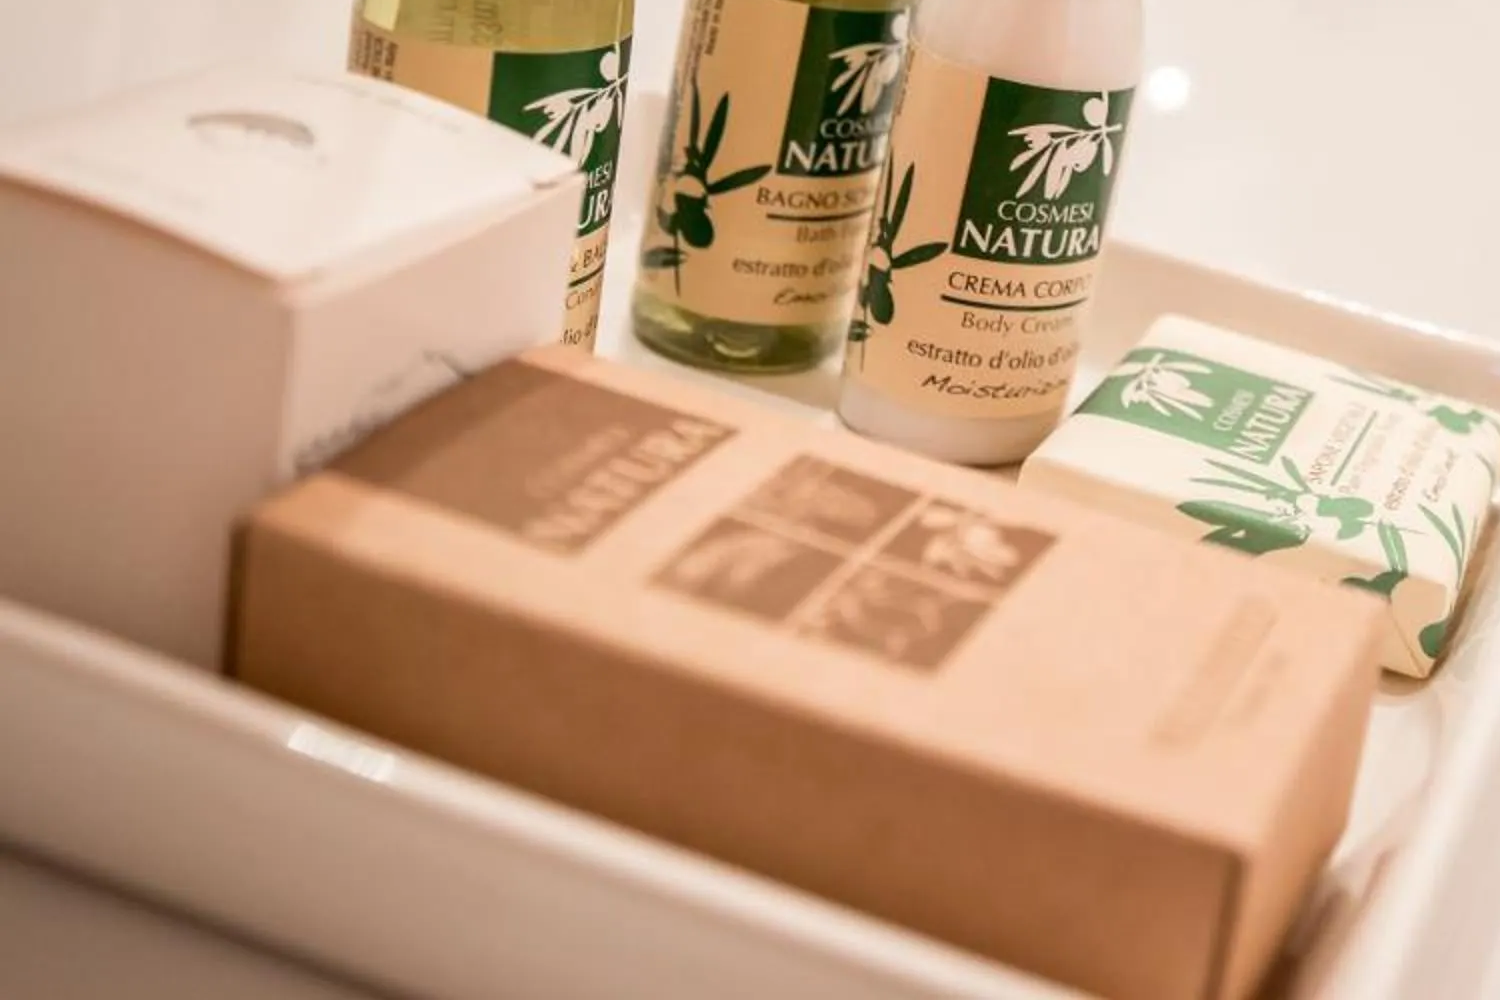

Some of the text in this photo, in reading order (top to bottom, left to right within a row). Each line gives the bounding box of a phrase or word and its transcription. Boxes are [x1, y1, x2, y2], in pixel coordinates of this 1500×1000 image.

[784, 140, 883, 172] NATU
[756, 186, 840, 210] BAGNO
[997, 198, 1095, 225] COSMESI
[959, 218, 1102, 259] NATURA
[731, 256, 808, 278] estratto
[947, 270, 1027, 298] CREMA
[960, 310, 1014, 337] Body
[906, 337, 983, 368] estratto
[988, 348, 1046, 370] d'olio
[1227, 384, 1309, 462] NATURA
[525, 416, 728, 551] NATURA
